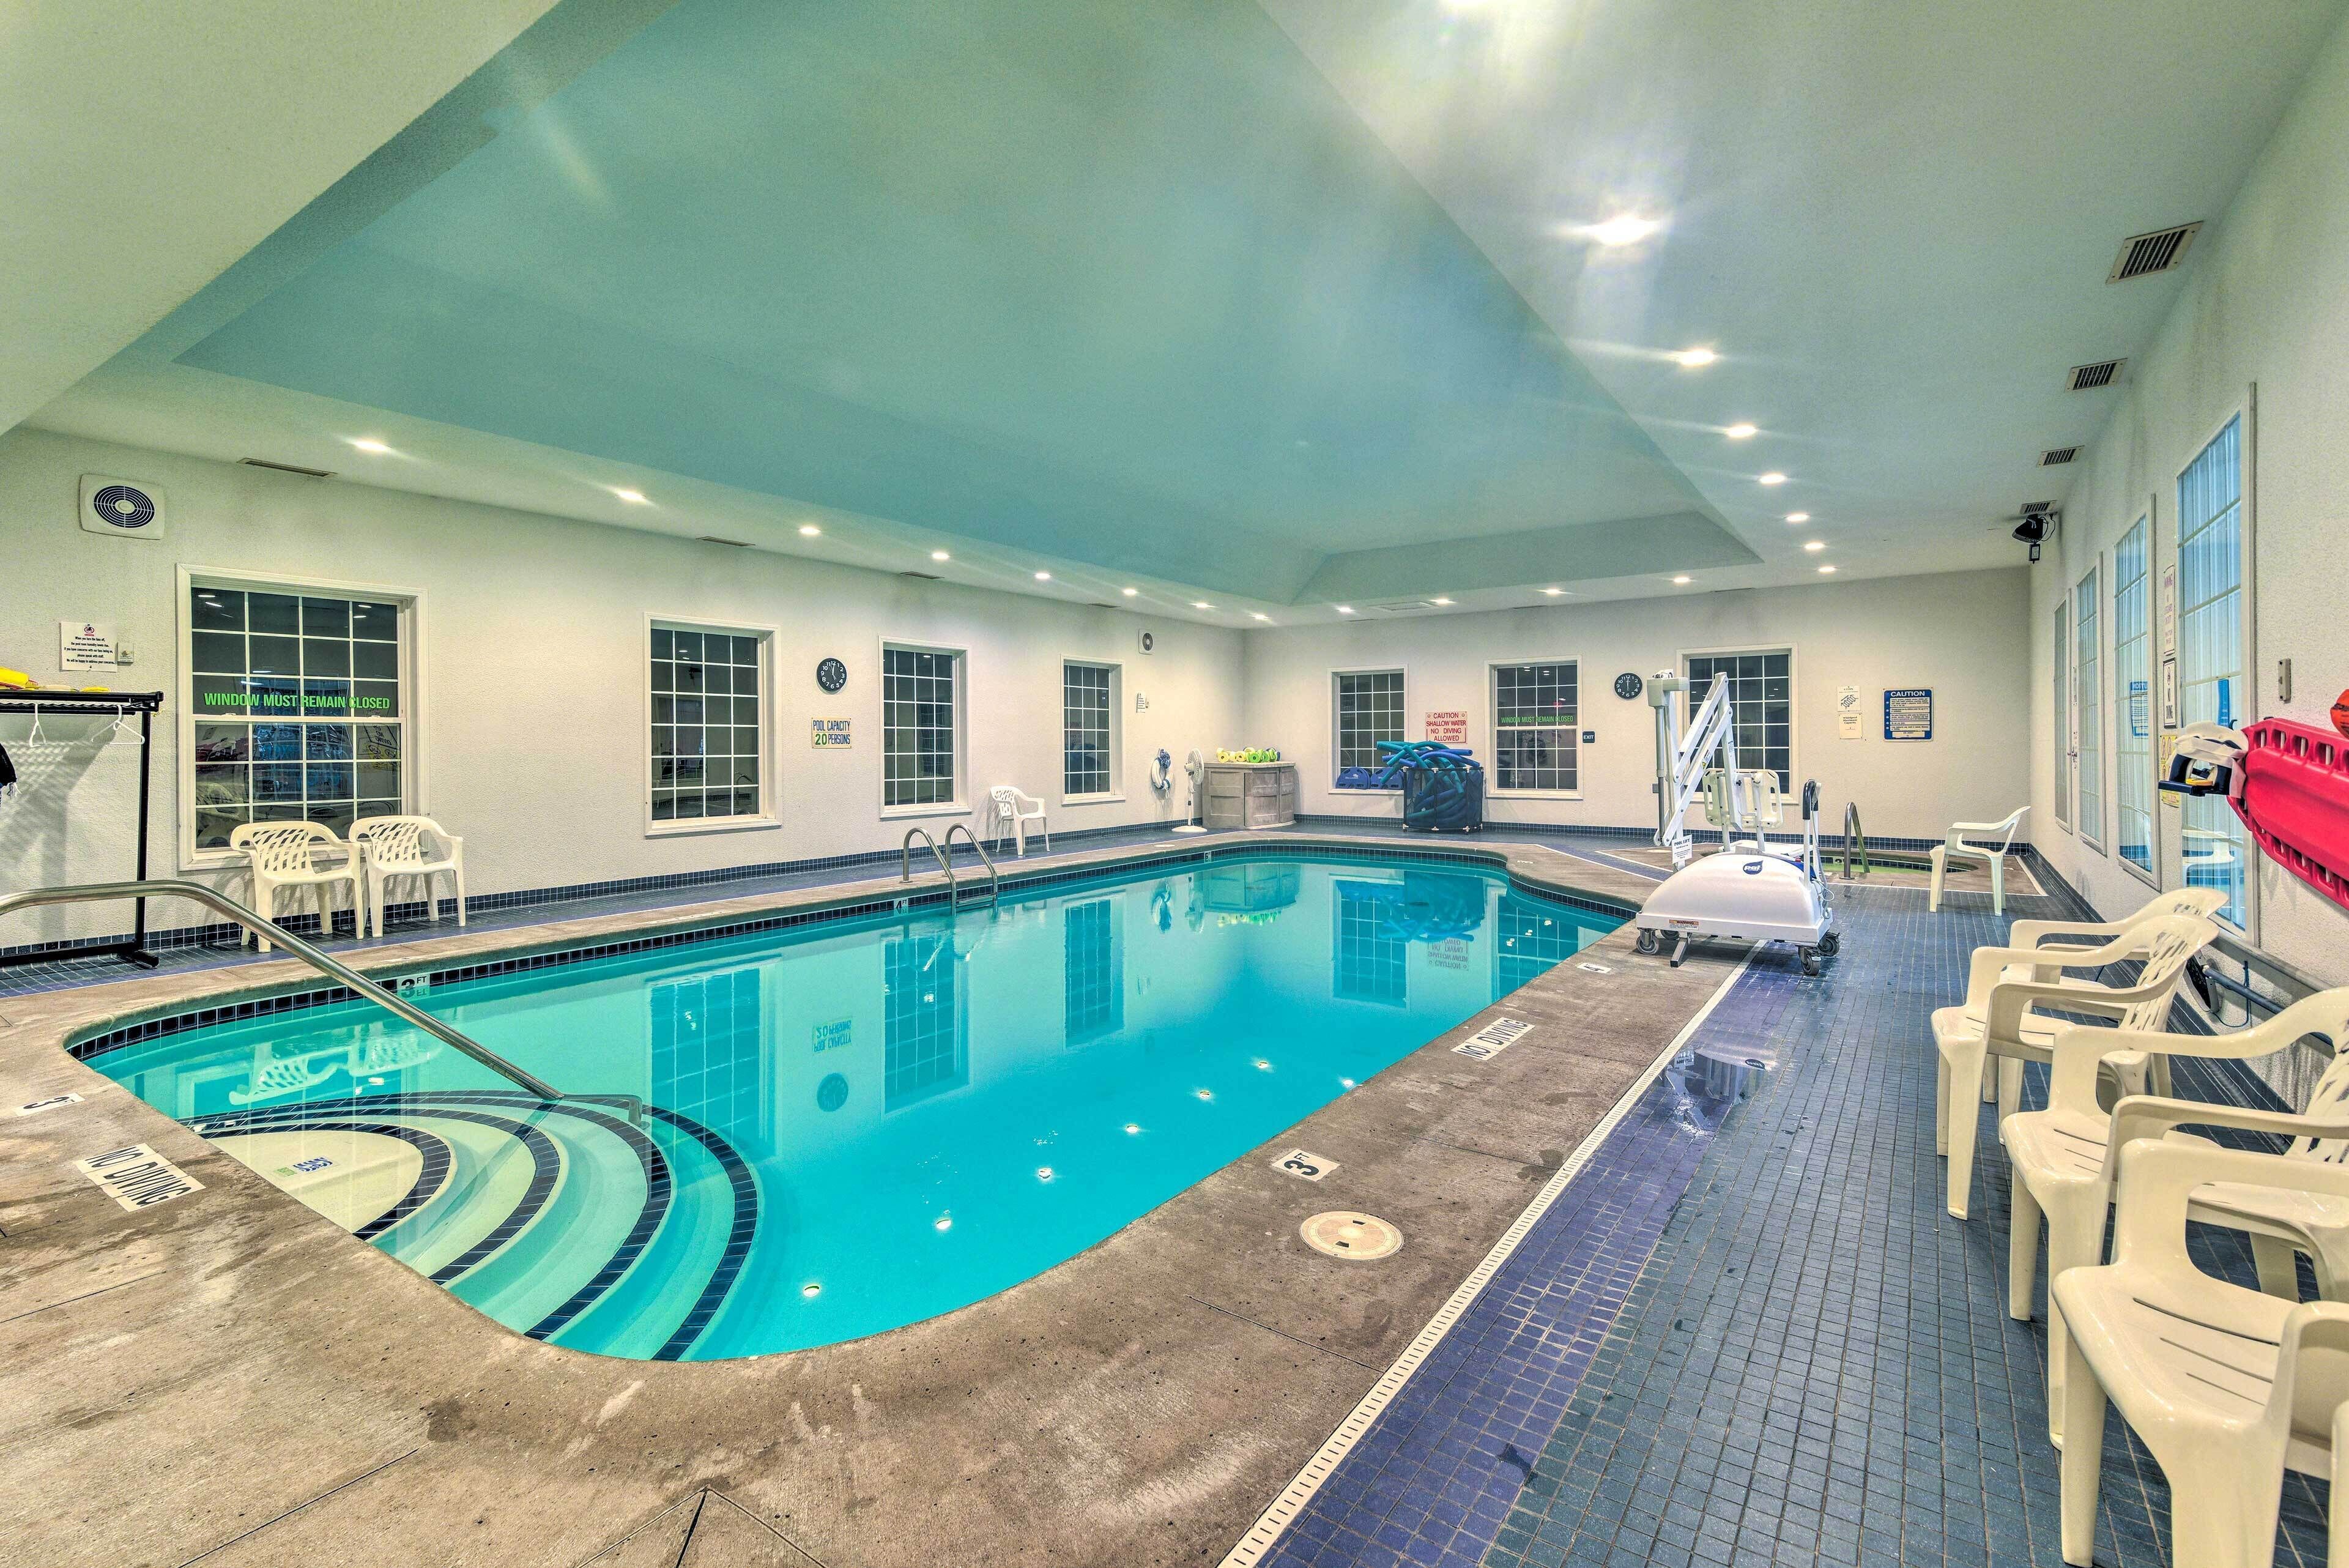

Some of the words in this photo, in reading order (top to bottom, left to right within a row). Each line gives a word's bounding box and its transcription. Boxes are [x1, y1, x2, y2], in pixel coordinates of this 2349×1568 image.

[204, 693, 259, 706] WINDOW
[264, 694, 298, 707] MUST
[302, 696, 346, 708] REMAIN
[349, 697, 390, 709] CLOSED
[813, 720, 826, 731] POOL
[827, 720, 850, 731] CAPACITY
[815, 733, 827, 745] 20
[828, 734, 850, 745] PERSONS
[1457, 1045, 1491, 1058] NO
[1477, 1019, 1528, 1046] DIVING
[23, 1096, 70, 1109] 3
[85, 1146, 144, 1168] NO
[1294, 1153, 1310, 1161] FT
[1284, 1160, 1319, 1176] 3
[103, 1161, 191, 1207] DIVING
